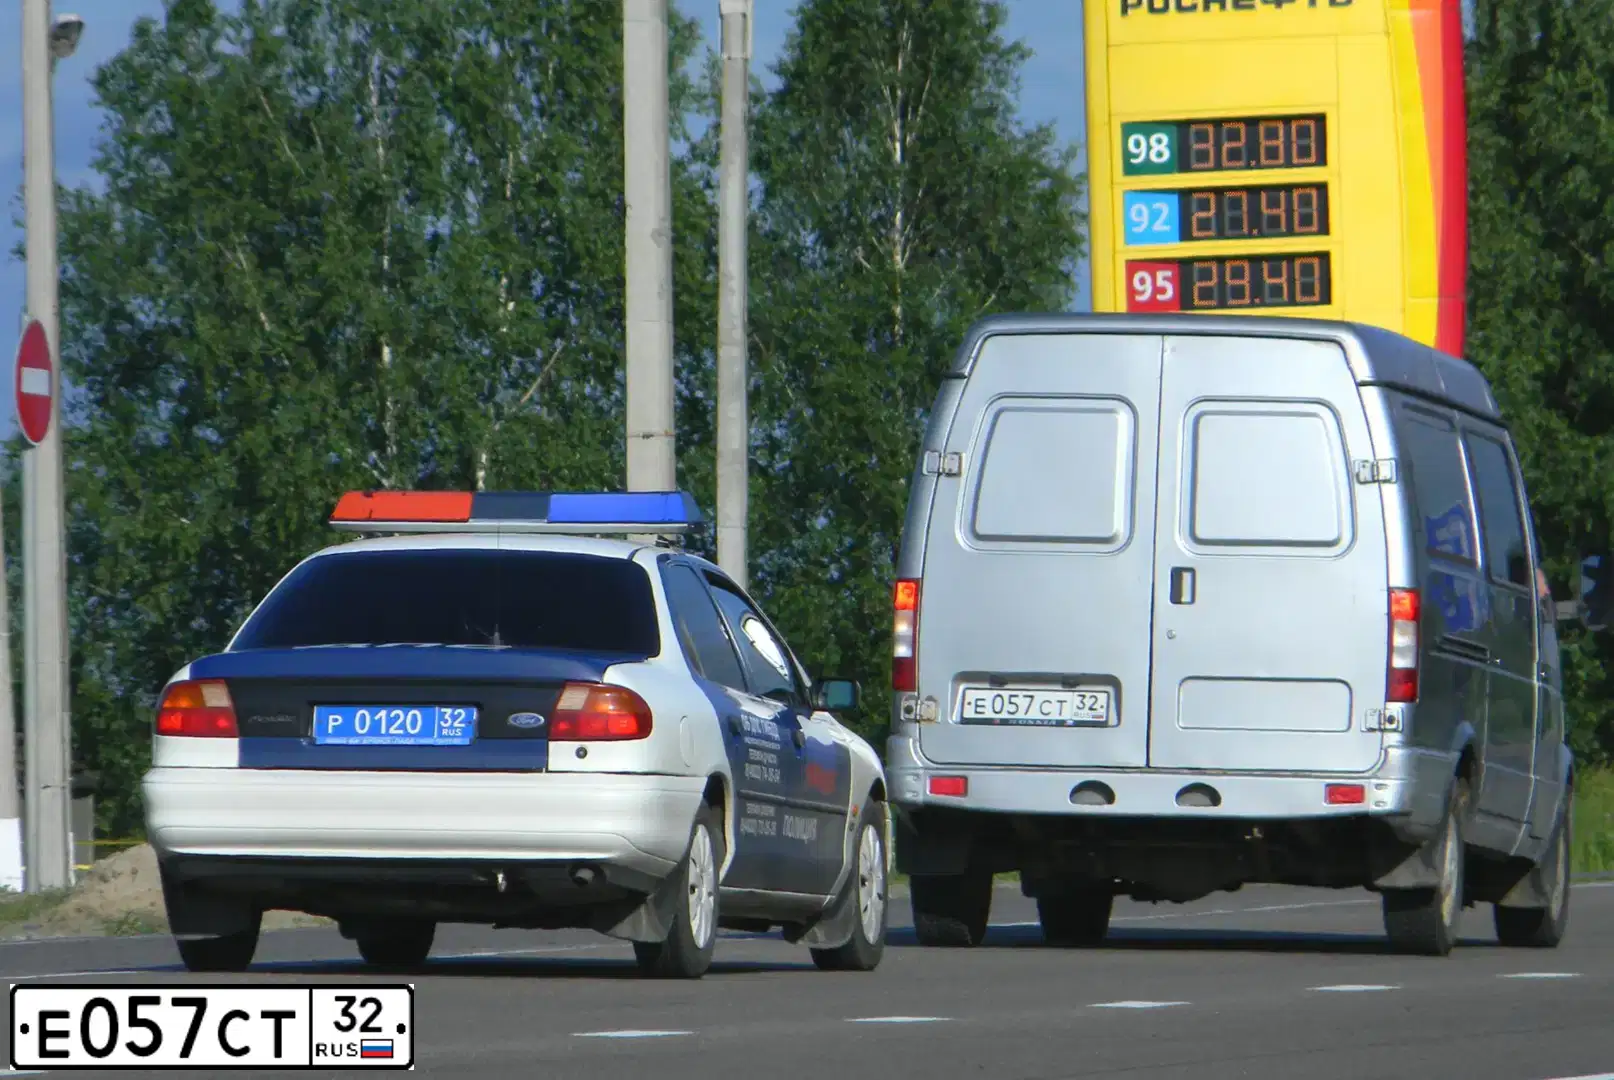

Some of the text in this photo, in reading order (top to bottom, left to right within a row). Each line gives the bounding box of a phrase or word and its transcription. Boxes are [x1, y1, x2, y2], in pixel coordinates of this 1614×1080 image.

[1127, 119, 1317, 169] 98 32.80
[1129, 187, 1319, 238] 92 27.40
[1132, 256, 1320, 305] 95 29.40
[354, 709, 422, 734] 0120
[439, 708, 466, 727] 32
[1075, 694, 1099, 711] 32
[441, 728, 462, 736] RUS
